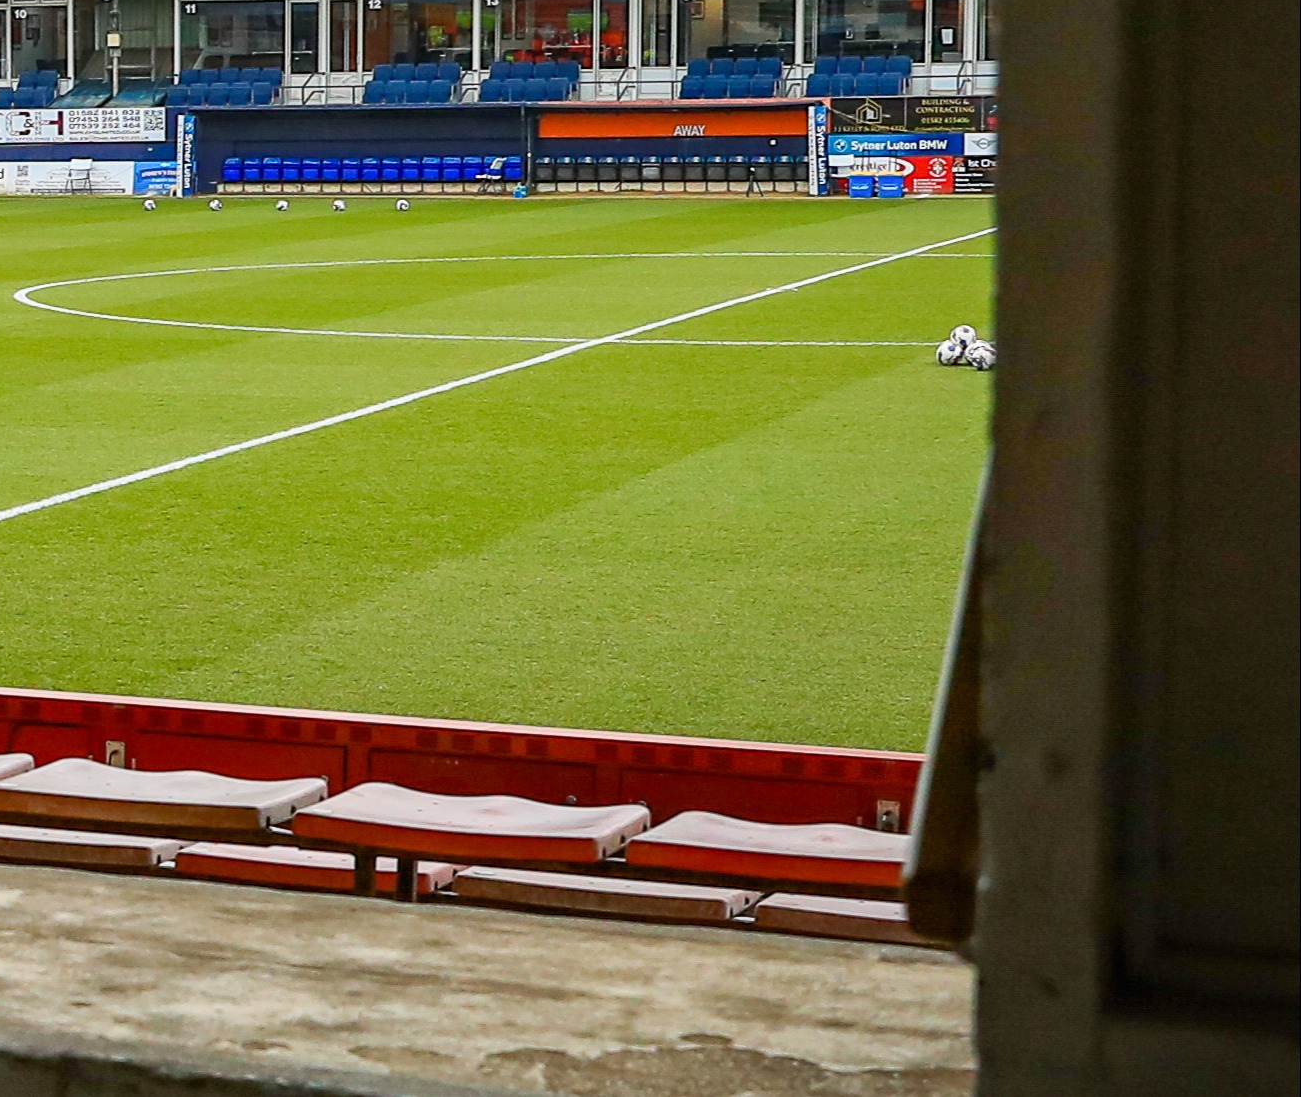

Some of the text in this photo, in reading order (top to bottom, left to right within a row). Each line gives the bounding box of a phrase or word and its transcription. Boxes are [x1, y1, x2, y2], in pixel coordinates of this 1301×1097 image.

[185, 4, 196, 14] 11
[368, 0, 382, 10] 12
[14, 9, 28, 19] 10
[915, 106, 975, 114] CONTRACTING
[673, 124, 706, 137] AWAY
[851, 139, 948, 152] Sytner Luton BMW
[184, 133, 193, 188] Sytner Luton
[816, 125, 826, 185] Sytner Luton
